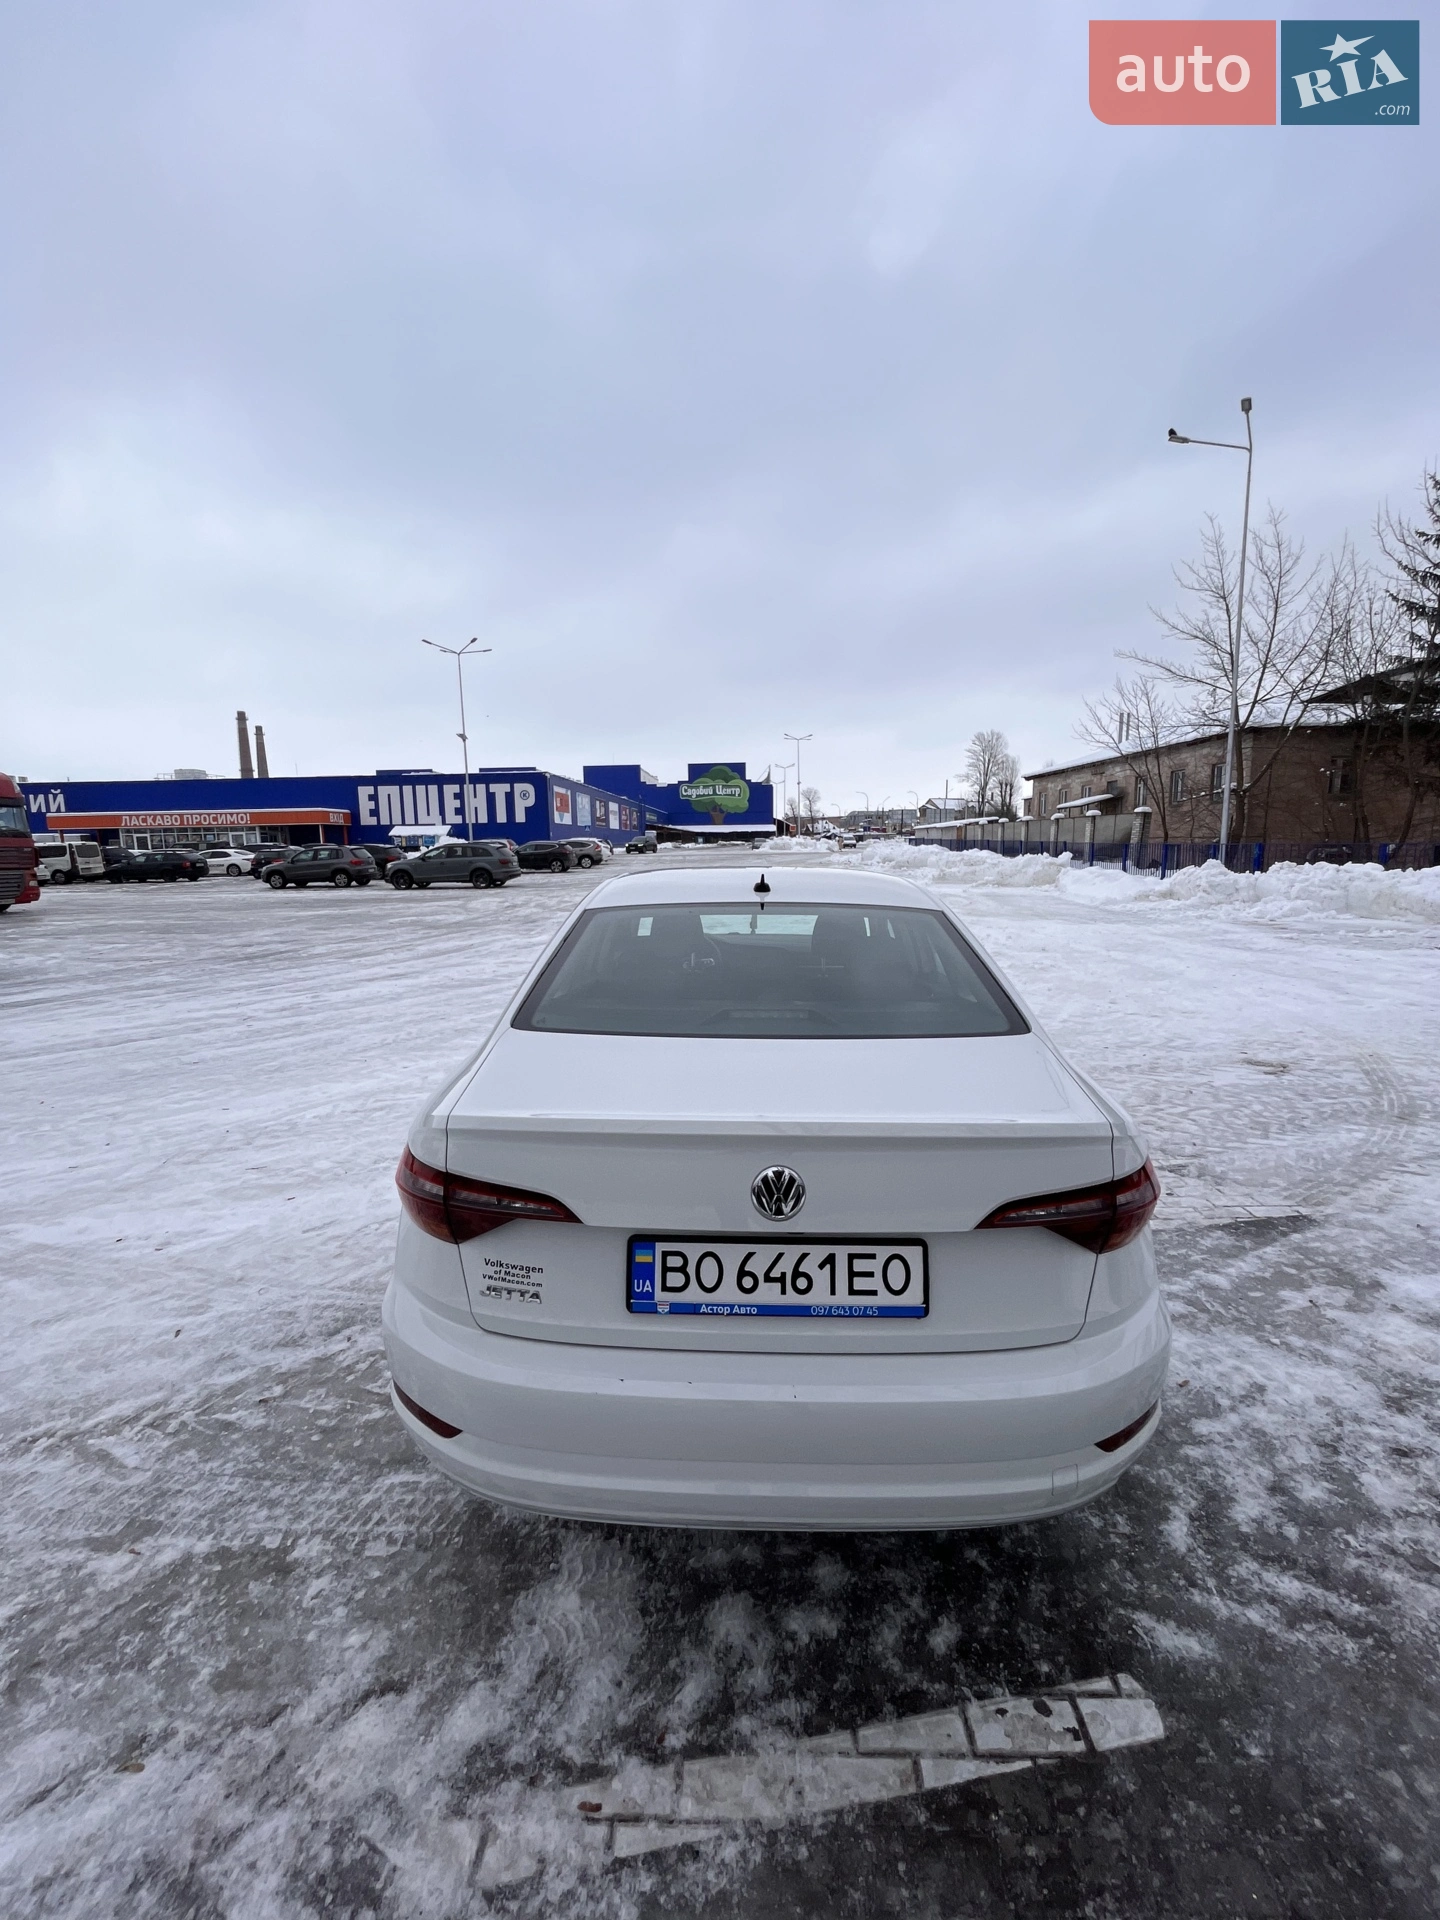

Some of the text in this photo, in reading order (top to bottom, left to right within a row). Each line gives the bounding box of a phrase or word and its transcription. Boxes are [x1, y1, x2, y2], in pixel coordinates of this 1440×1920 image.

[681, 784, 741, 798] Садовий Центр
[23, 789, 66, 813] ИЙ
[357, 783, 536, 826] ЕПІЦЕНТР
[121, 812, 251, 827] ЛАСКАВО ПРОСИМО!
[329, 812, 345, 825] ВХІД
[484, 1257, 544, 1274] Volkswagen
[482, 1273, 543, 1288] VWofMacon.com
[503, 1270, 531, 1280] Macon
[634, 1279, 653, 1293] UA
[479, 1283, 543, 1305] JETTA
[700, 1303, 758, 1316] Астор Авто
[810, 1305, 879, 1316] 097 643 07 45
